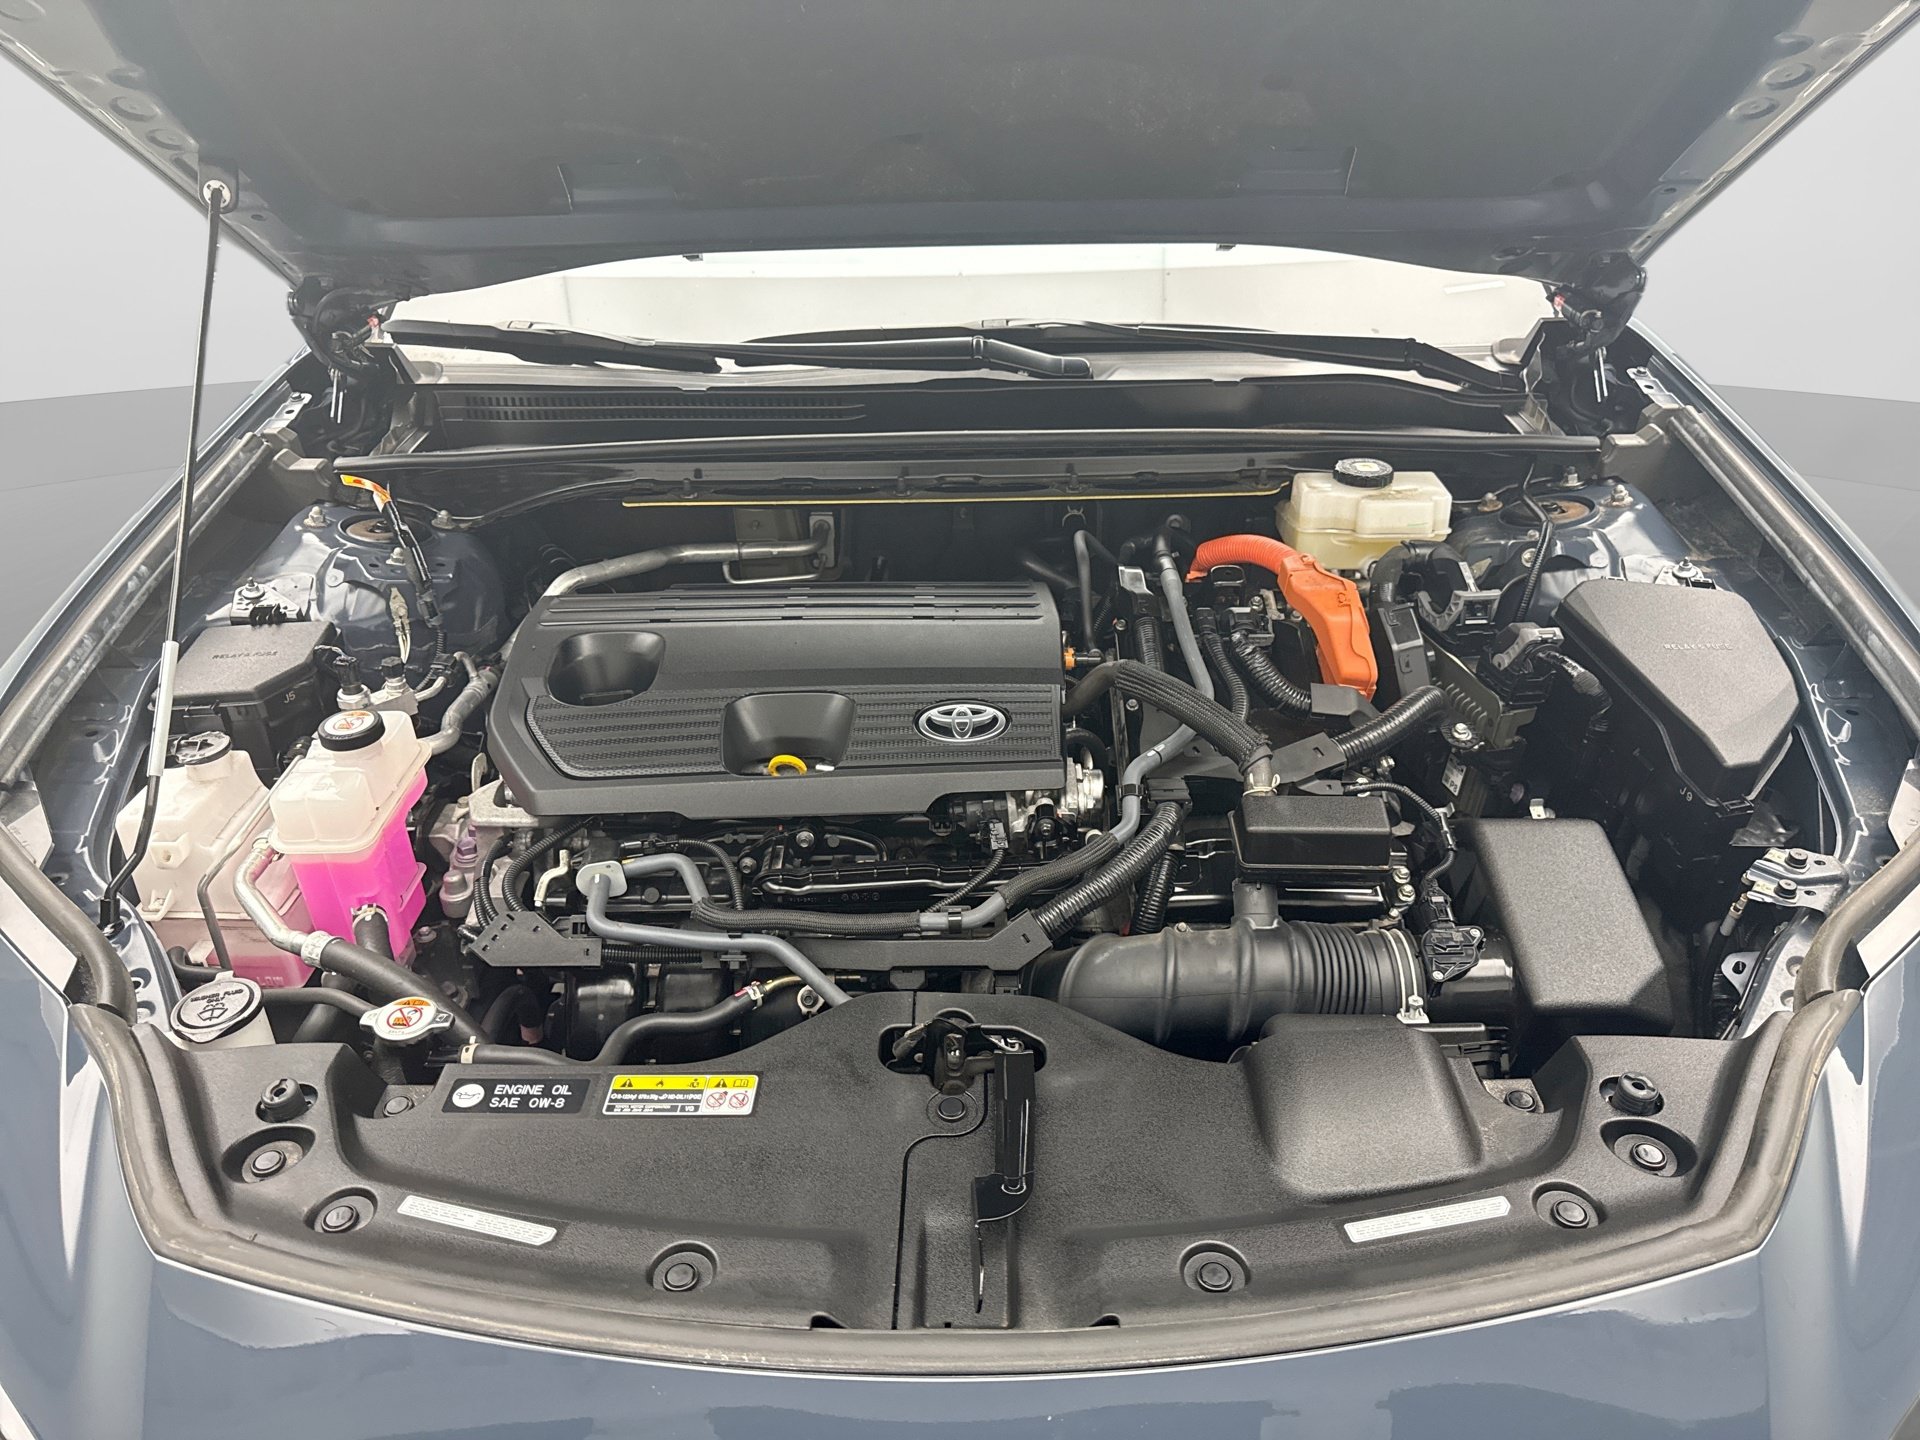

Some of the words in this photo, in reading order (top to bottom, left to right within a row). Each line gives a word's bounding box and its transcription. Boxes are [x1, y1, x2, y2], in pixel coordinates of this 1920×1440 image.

[284, 691, 296, 703] J5
[494, 1084, 545, 1095] ENGINE
[551, 1084, 572, 1095] OIL
[489, 1097, 520, 1108] SAE
